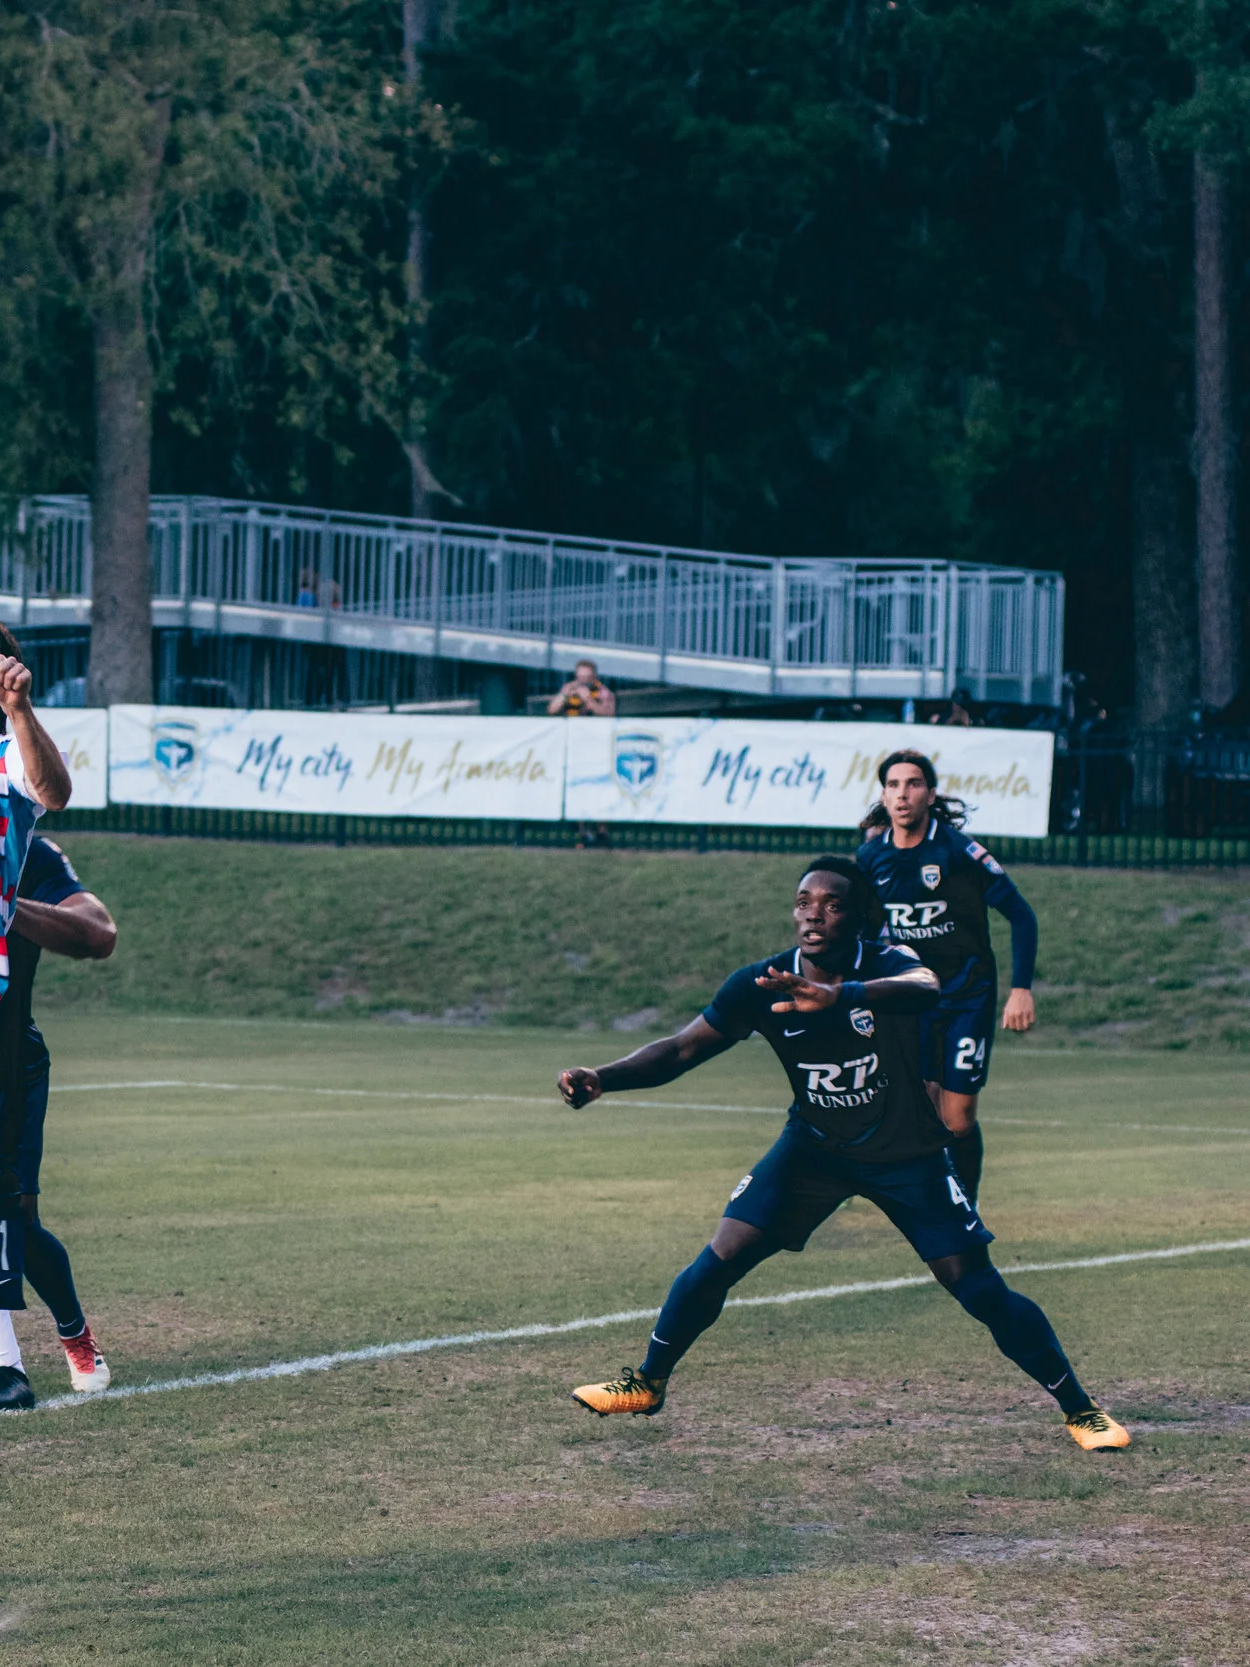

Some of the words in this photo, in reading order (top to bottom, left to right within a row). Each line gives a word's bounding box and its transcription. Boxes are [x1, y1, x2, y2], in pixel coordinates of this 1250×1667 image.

[237, 734, 293, 797] My
[366, 737, 424, 794] My
[702, 744, 762, 809] My
[840, 749, 888, 805] M
[884, 900, 948, 927] RP
[954, 1037, 986, 1069] 24
